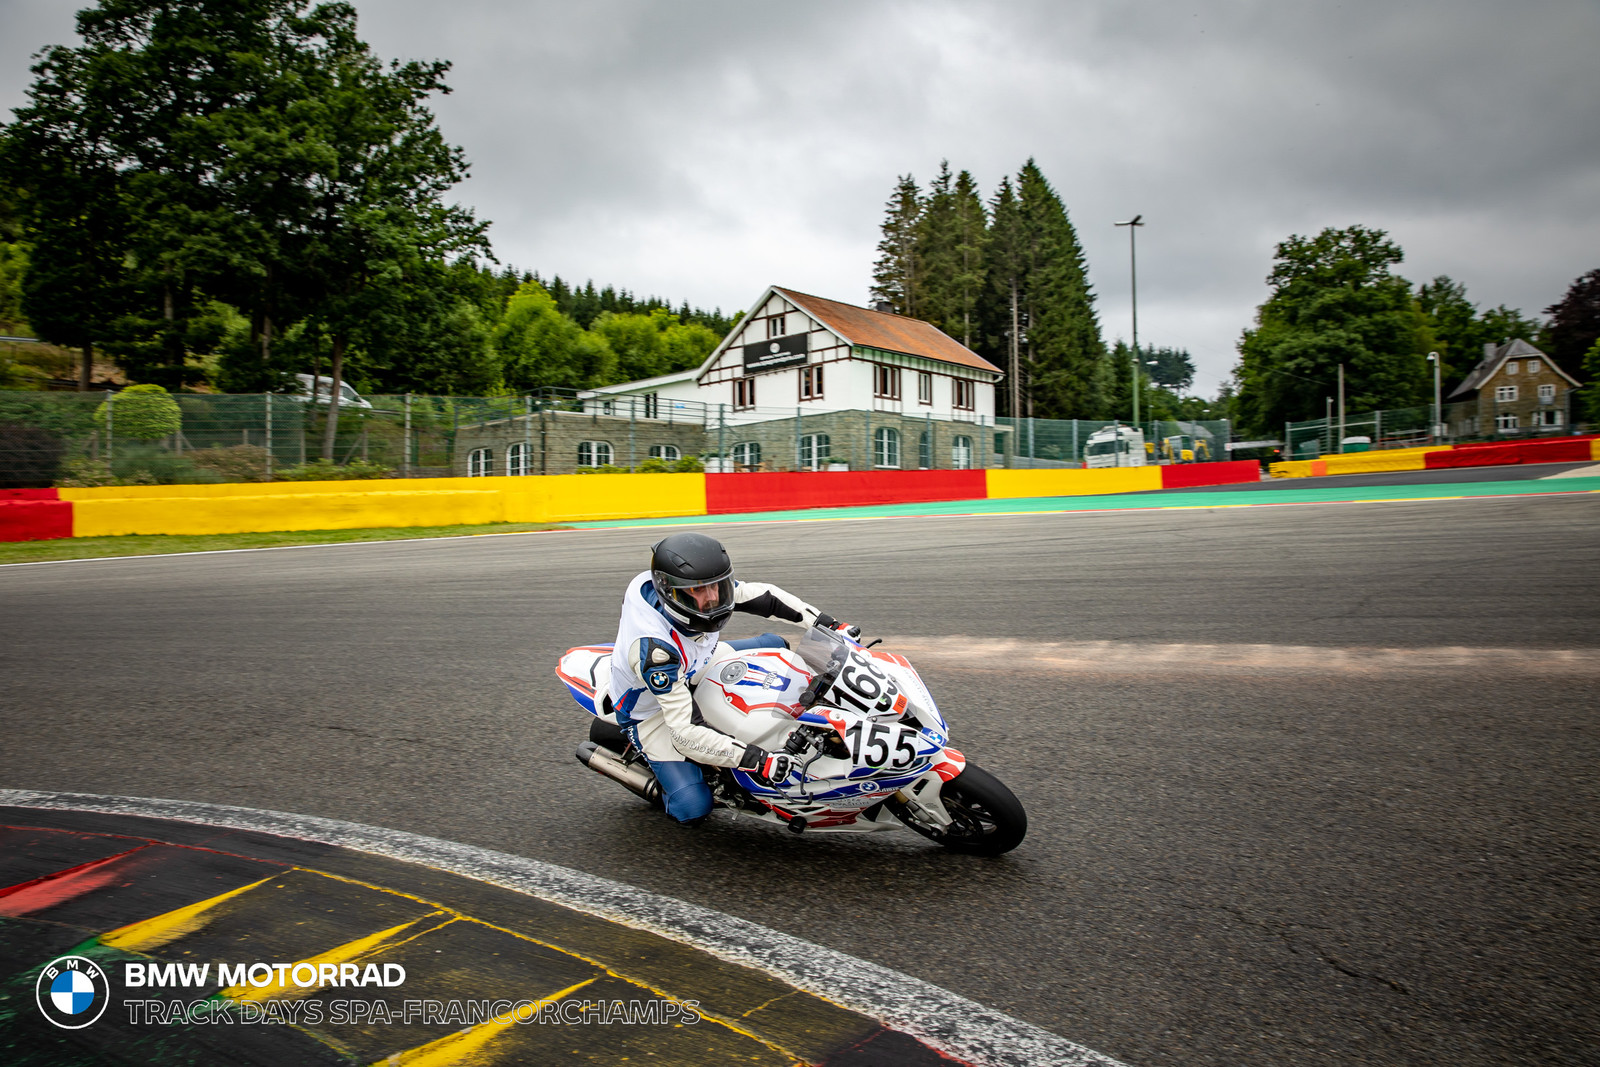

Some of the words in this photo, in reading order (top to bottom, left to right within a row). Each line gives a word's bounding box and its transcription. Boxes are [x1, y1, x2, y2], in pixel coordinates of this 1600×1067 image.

[832, 651, 886, 713] 168
[689, 740, 735, 758] Motorrad
[845, 720, 917, 768] 155
